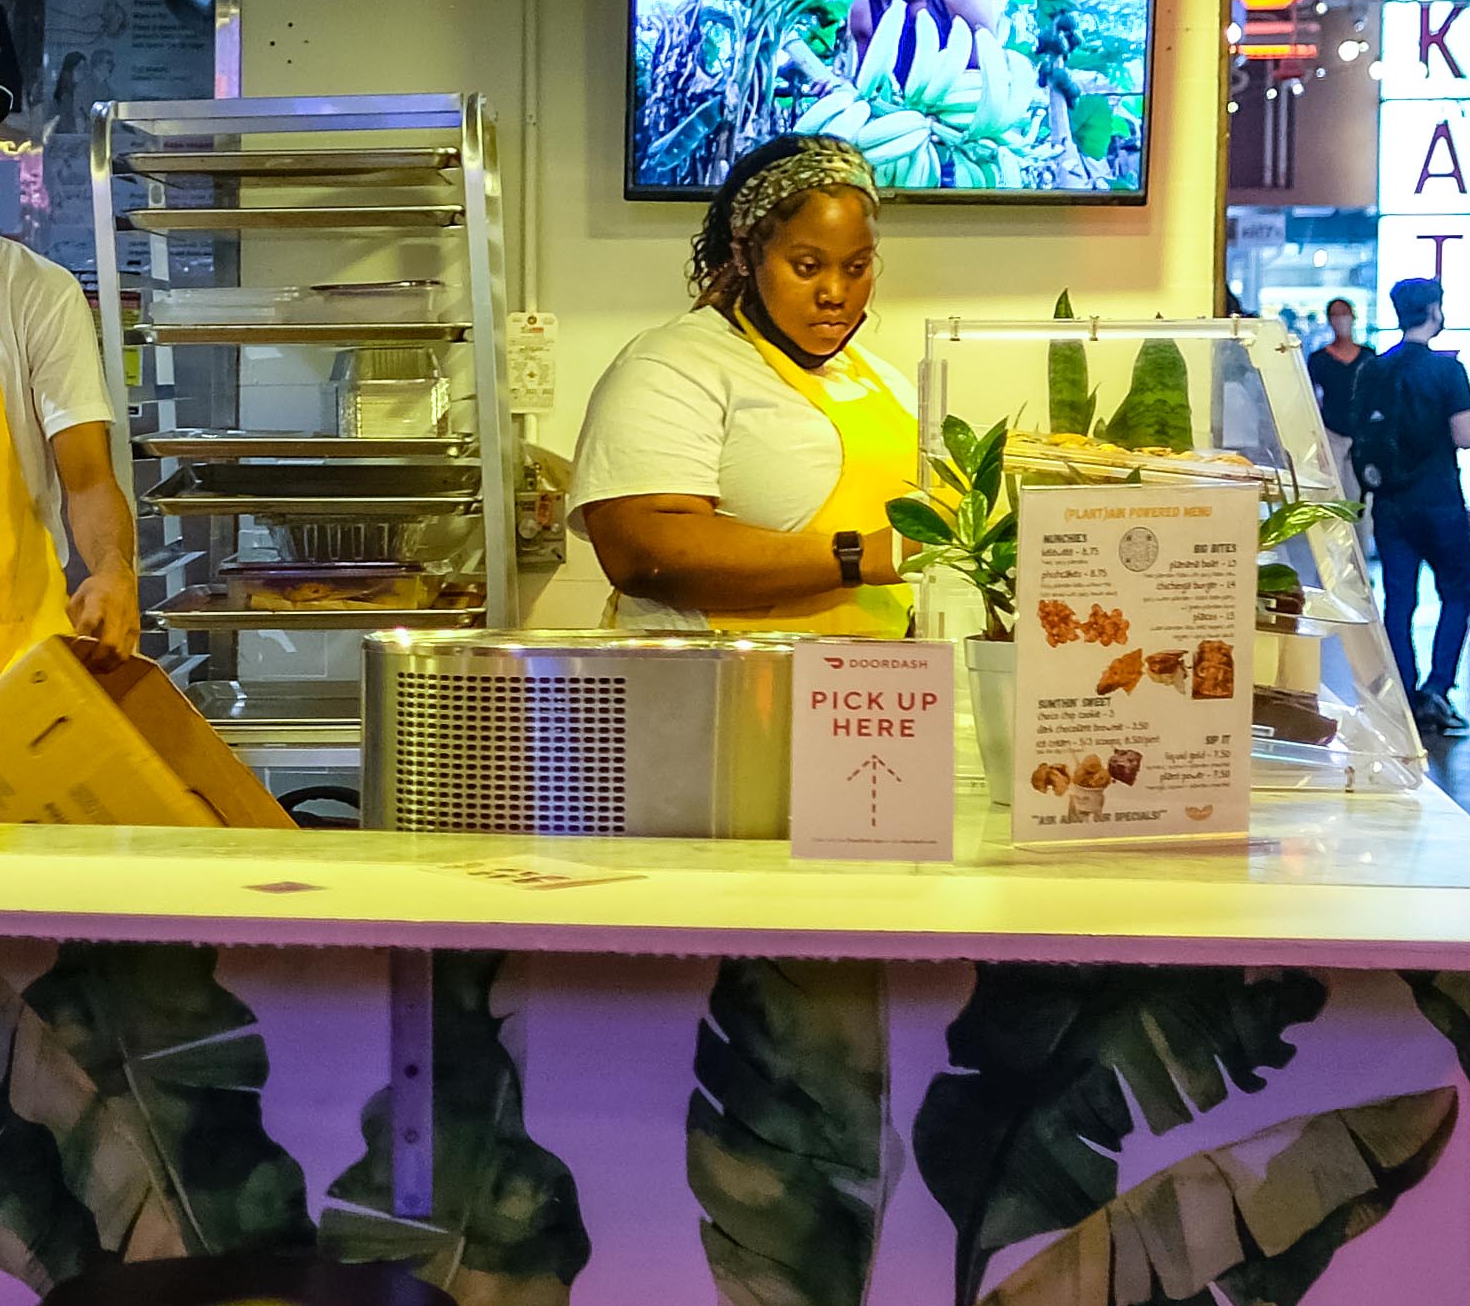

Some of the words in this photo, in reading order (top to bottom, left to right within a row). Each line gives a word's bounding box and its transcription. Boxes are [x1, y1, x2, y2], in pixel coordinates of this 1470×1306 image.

[1415, 2, 1468, 353] KAT
[848, 658, 929, 670] DOORDASH
[811, 691, 885, 711] PICK
[897, 692, 938, 712] UP
[832, 718, 916, 738] HERE
